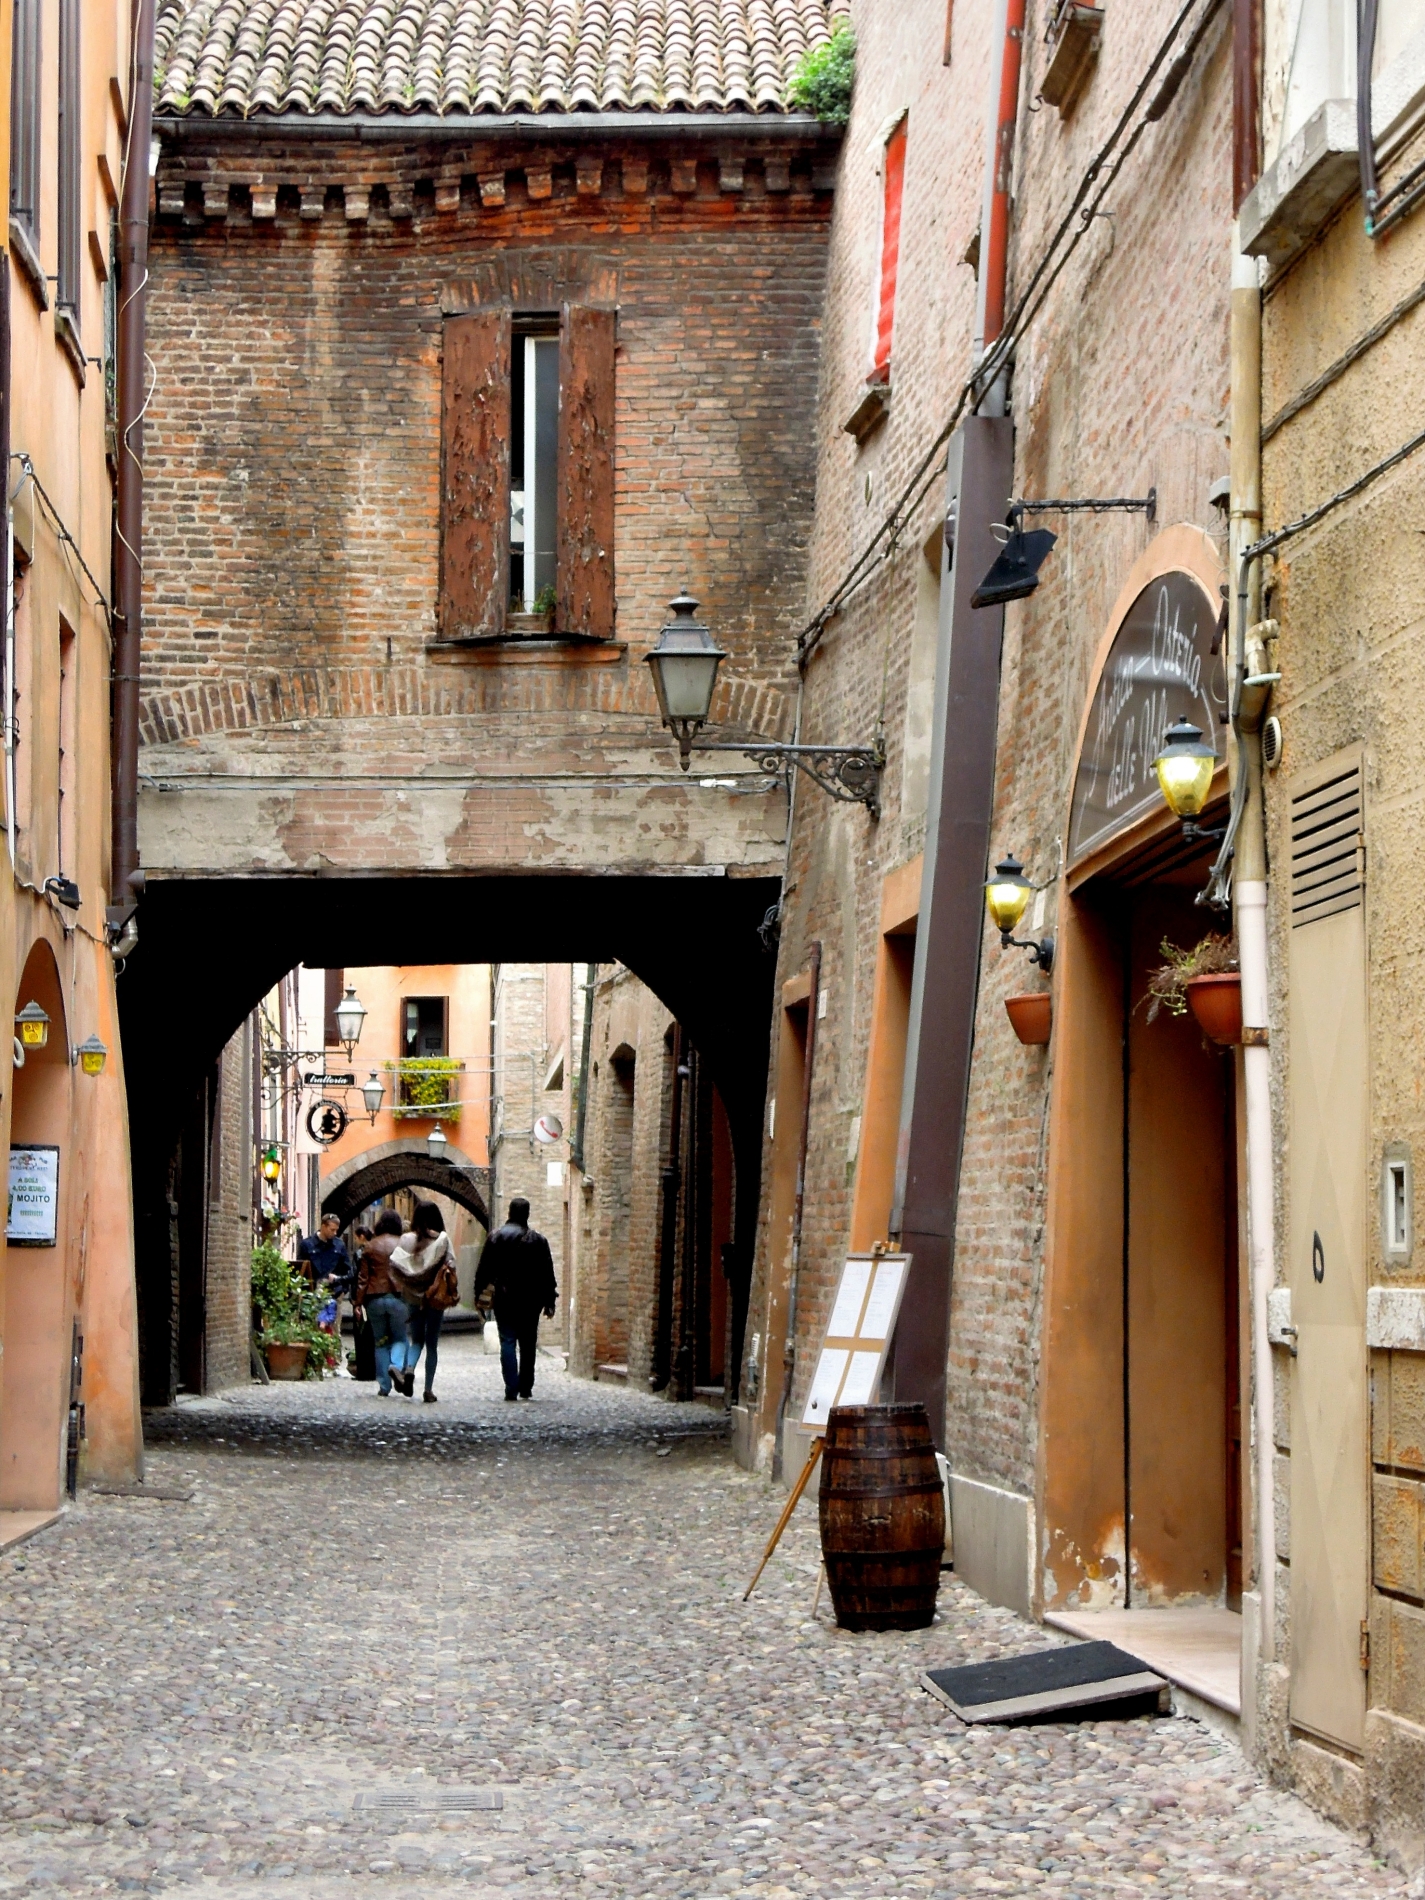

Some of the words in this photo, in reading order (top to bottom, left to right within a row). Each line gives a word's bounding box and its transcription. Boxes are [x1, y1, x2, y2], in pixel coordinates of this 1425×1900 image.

[309, 1075, 348, 1084] trattoria
[28, 1185, 47, 1193] EURO
[16, 1194, 51, 1203] MOJITO
